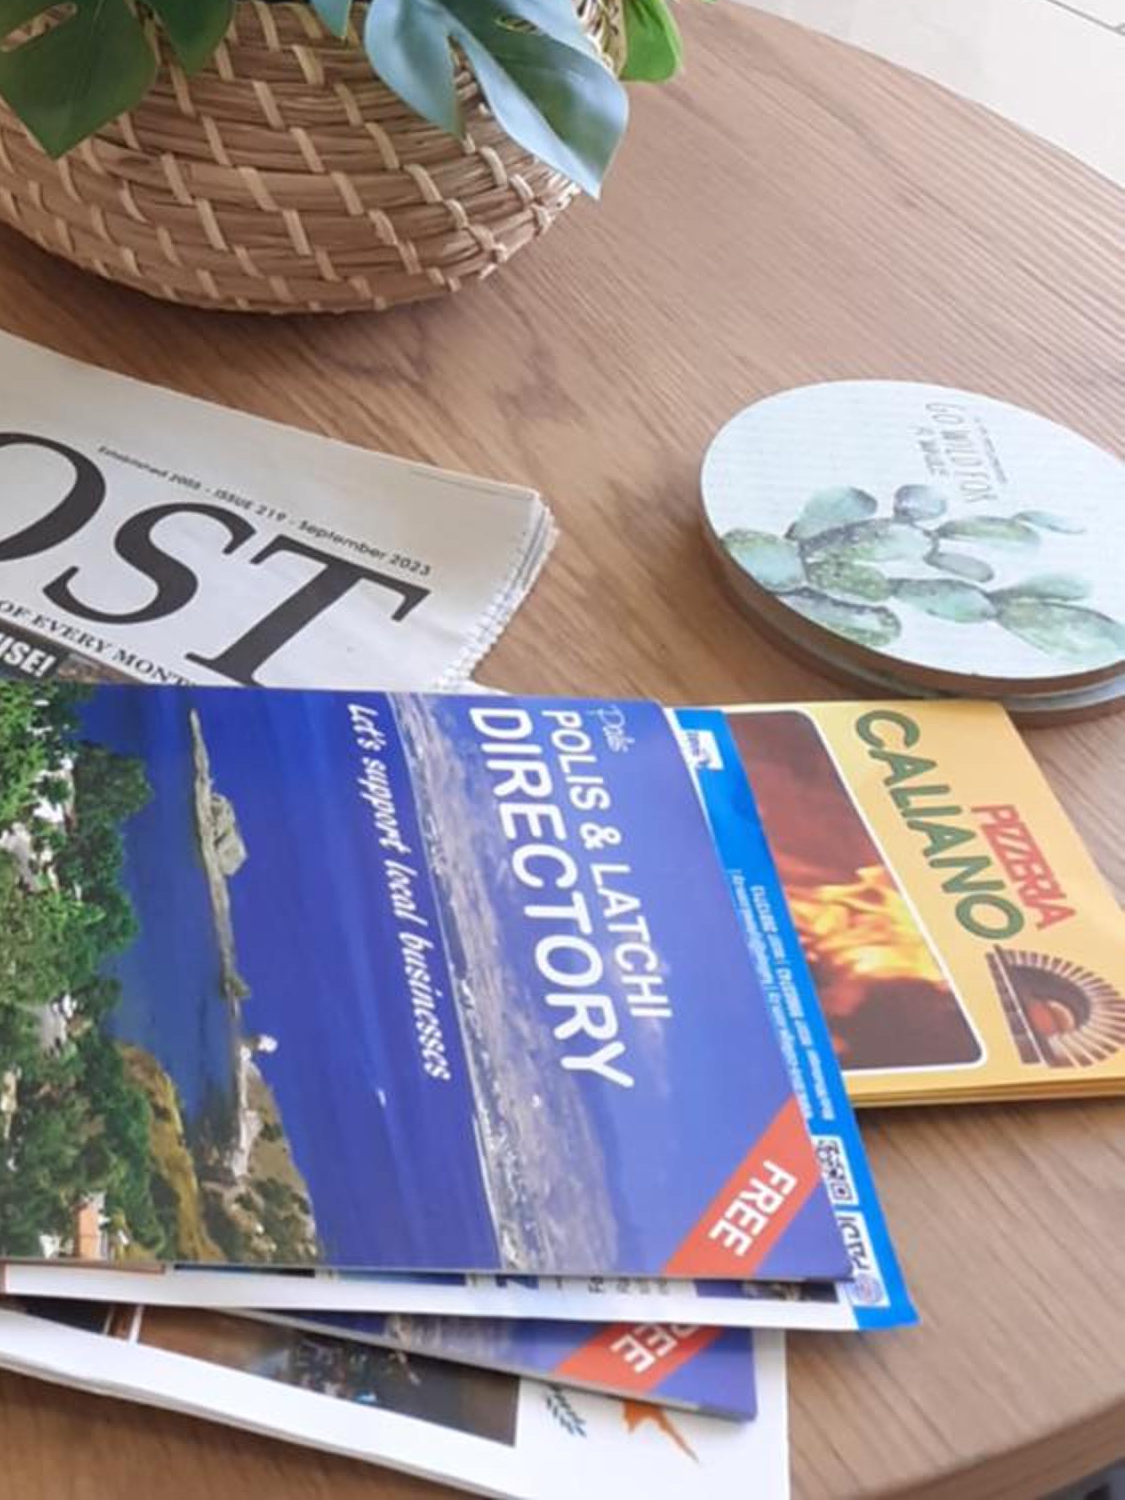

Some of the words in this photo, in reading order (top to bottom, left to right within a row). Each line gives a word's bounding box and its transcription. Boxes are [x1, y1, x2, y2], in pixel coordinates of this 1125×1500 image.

[298, 519, 387, 562] September
[390, 555, 434, 577] 2023
[32, 613, 113, 663] EVERY
[347, 703, 391, 753] Let's
[541, 708, 611, 812] POLIS
[356, 752, 412, 854] support
[580, 823, 622, 851] &
[855, 708, 1025, 941] CALIANO
[385, 855, 427, 930] local
[469, 705, 635, 1090] DIRECTORY
[971, 803, 1077, 932] PIZZERIA
[592, 861, 673, 1018] LATCHI
[399, 931, 452, 1083] businesses
[708, 1158, 798, 1258] FREE
